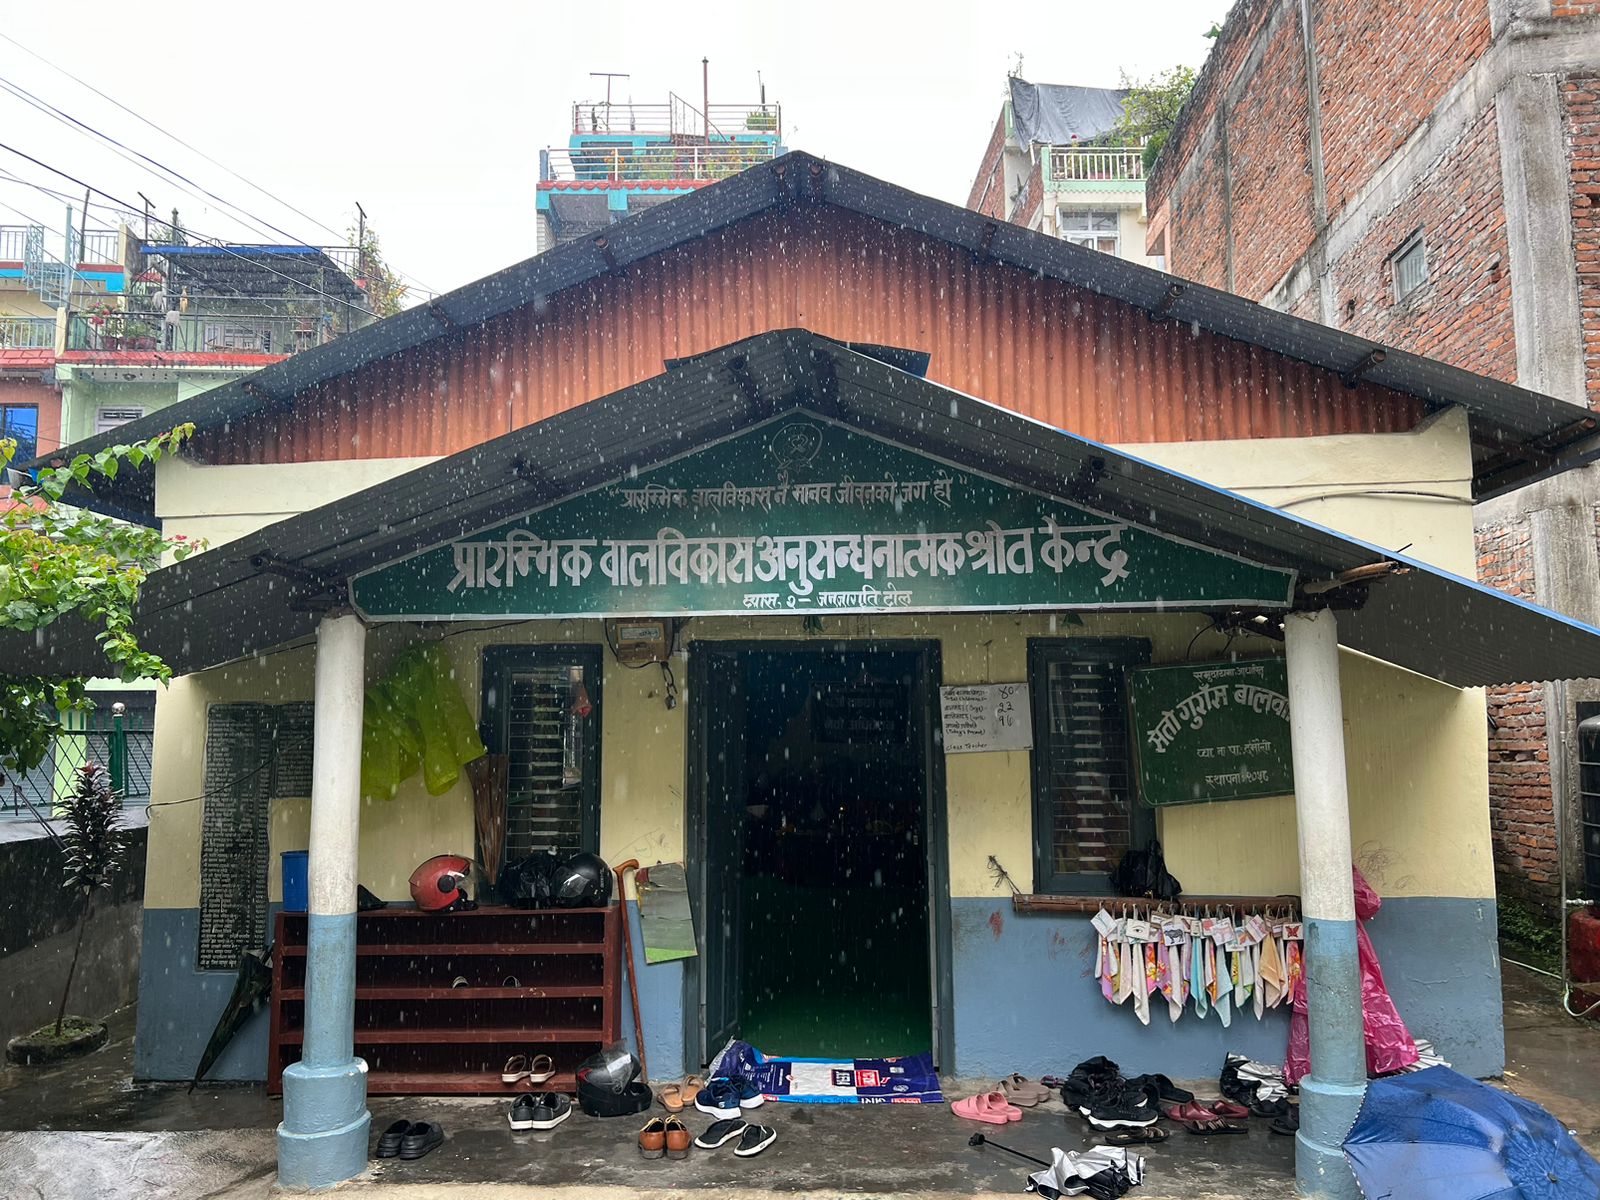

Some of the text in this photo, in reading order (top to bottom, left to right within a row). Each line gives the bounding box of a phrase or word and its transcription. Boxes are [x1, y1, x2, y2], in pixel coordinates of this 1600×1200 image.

[792, 482, 836, 505] मानव
[899, 480, 930, 504] जग
[446, 528, 598, 594] प्रारम्भिक
[965, 519, 1035, 575] श्रोत
[1037, 515, 1130, 588] केन्द्र
[882, 581, 913, 608] टोल
